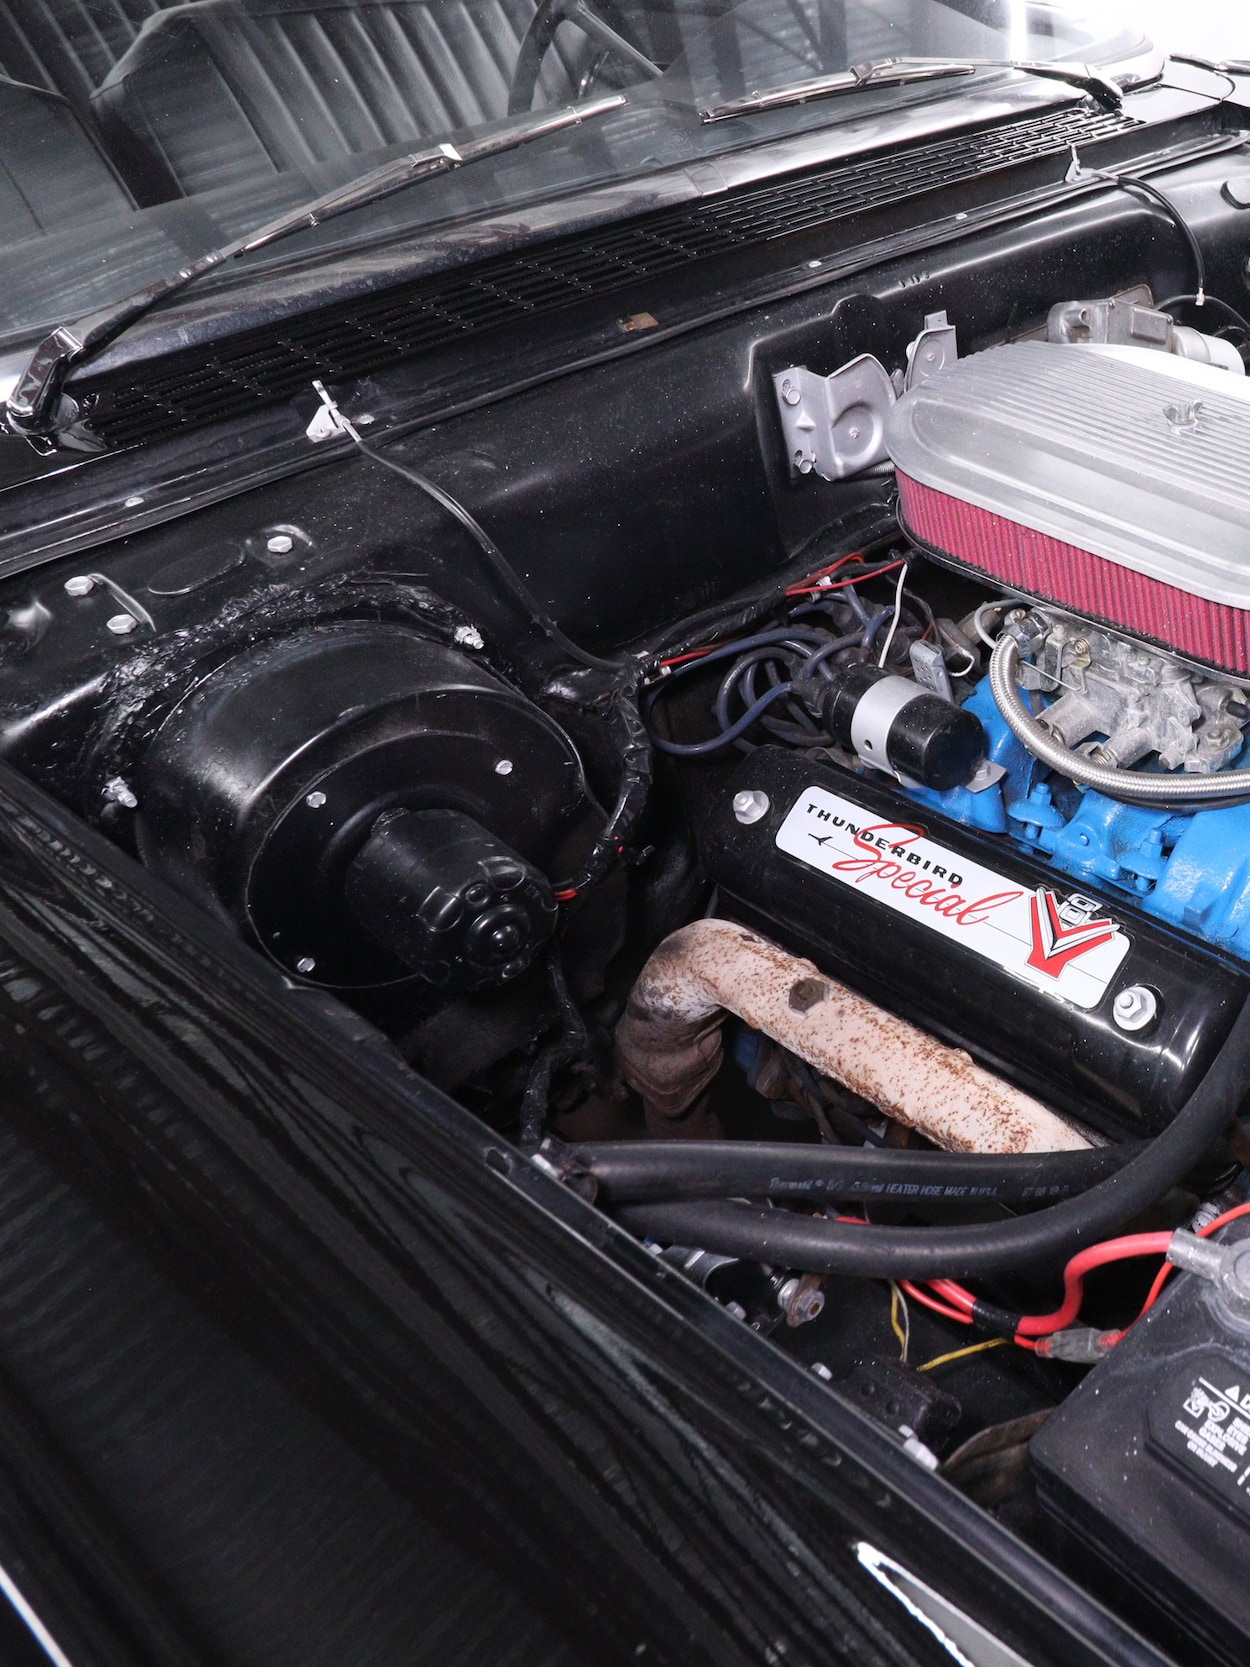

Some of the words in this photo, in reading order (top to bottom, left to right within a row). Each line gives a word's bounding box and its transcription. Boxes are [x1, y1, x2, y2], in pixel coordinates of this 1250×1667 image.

[806, 803, 964, 886] THUNDERBIRD
[832, 823, 1024, 926] Special
[885, 1183, 920, 1195] HEATER
[920, 1185, 944, 1195] HOSE
